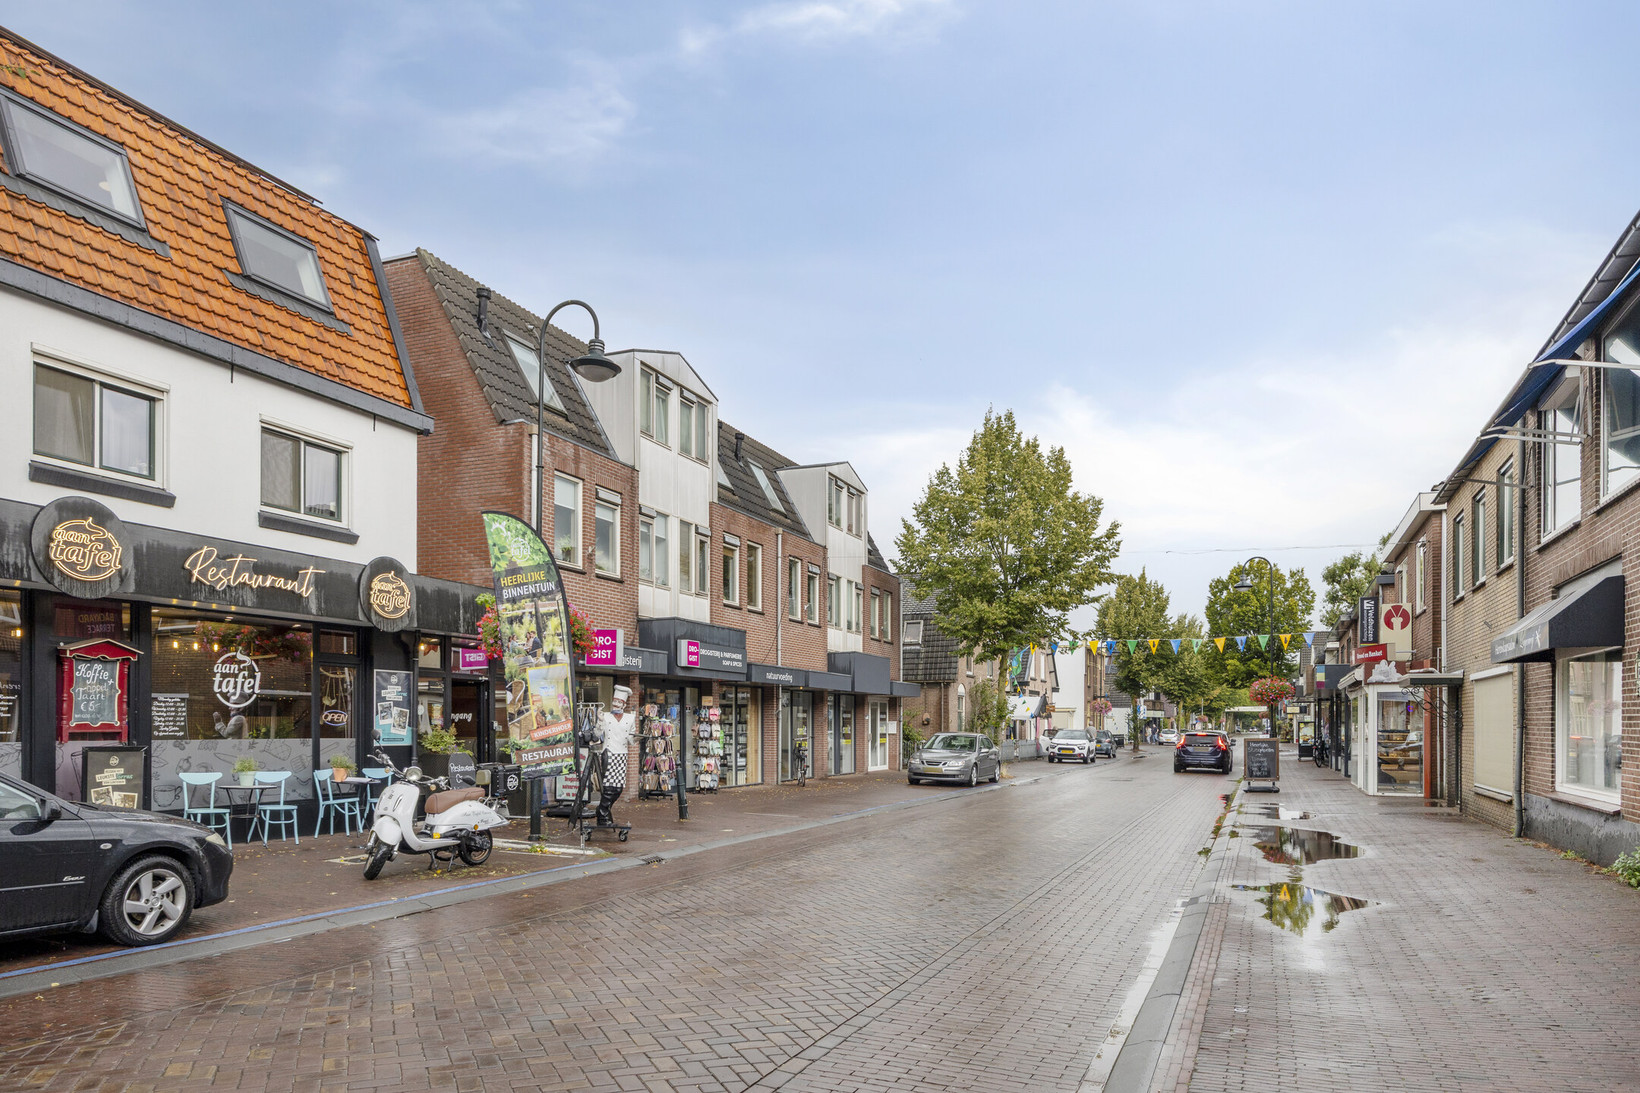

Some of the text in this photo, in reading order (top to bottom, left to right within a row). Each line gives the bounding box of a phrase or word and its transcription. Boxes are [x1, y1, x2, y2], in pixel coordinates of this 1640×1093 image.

[53, 529, 90, 545] aan
[50, 540, 122, 572] tafel
[184, 546, 326, 598] Restaurant
[500, 571, 546, 587] HEERLIJKE
[371, 580, 393, 591] aan
[502, 581, 556, 599] BINNENTUIN
[370, 588, 411, 612] tafel
[591, 649, 613, 659] GIST
[688, 645, 700, 653] DRO-
[76, 663, 109, 685] Koffie
[213, 663, 239, 674] aan
[212, 671, 262, 700] tafel
[75, 687, 106, 701] Taart
[322, 713, 348, 723] OPEN
[450, 712, 472, 722] ngang
[534, 722, 572, 738] KINDERHOEK
[521, 746, 574, 762] RESTAURAN
